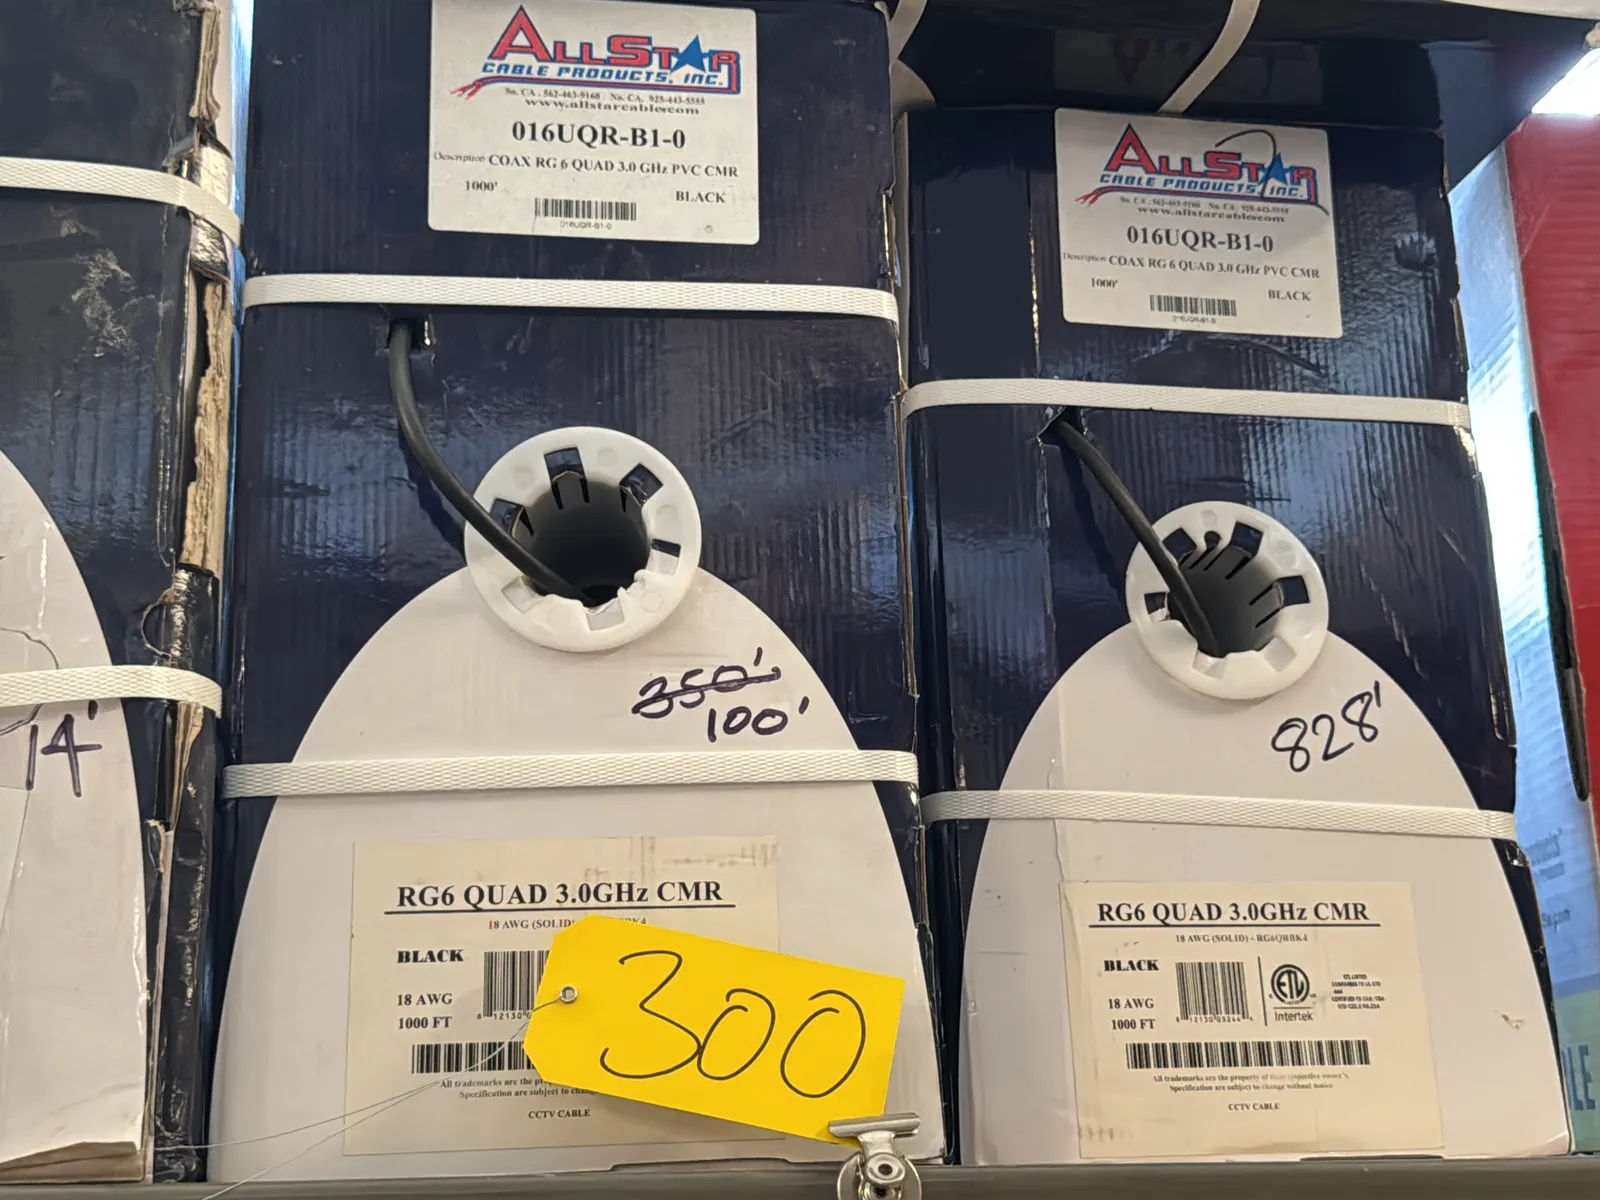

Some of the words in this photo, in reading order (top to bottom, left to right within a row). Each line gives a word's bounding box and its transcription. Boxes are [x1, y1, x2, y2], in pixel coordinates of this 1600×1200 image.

[481, 62, 549, 77] CABLE
[684, 73, 724, 86] INC.
[525, 98, 700, 115] www.allstarcable.com
[512, 121, 686, 149] 016UQR-B1-0
[488, 154, 531, 167] COAX
[536, 156, 557, 169] RG
[560, 158, 568, 169] 6
[572, 159, 614, 173] QUAD
[617, 161, 637, 172] 3.0
[639, 163, 668, 174] GHz
[672, 164, 701, 176] PVC
[704, 165, 738, 177] CMR
[465, 180, 498, 192] 1000'
[1100, 173, 1156, 187] CABLE
[1269, 186, 1304, 198] INC.
[676, 190, 726, 204] BLACK
[1127, 225, 1273, 253] 016UQR-B1-0
[1108, 255, 1144, 267] COAX
[1148, 258, 1166, 269] RG
[1169, 258, 1176, 269] 6
[1178, 260, 1215, 272] QUAD
[1217, 262, 1234, 273] 3.0
[1235, 263, 1261, 275] GHz
[1264, 265, 1288, 277] PVC
[1290, 267, 1320, 279] CMR
[1268, 289, 1312, 302] BLACK
[707, 696, 809, 743] 100'
[1271, 680, 1381, 773] 828'
[396, 885, 455, 907] RG6
[464, 884, 547, 911] QUAD
[555, 882, 649, 905] 3.0GHz
[657, 880, 723, 902] CMR
[1097, 902, 1146, 922] RG6
[1152, 902, 1222, 926] QUAD
[1229, 902, 1308, 922] 3.0GHz
[1313, 902, 1370, 921] CMR
[488, 920, 500, 930] 18
[502, 919, 529, 930] AWG
[1176, 934, 1186, 943] 18
[1187, 934, 1210, 943] AWG
[1211, 934, 1249, 943] (SOLID)
[397, 949, 464, 963] BLACK
[1103, 960, 1160, 972] BLACK
[397, 994, 412, 1006] 18
[416, 993, 453, 1005] AWG
[1108, 998, 1121, 1010] 18
[1123, 998, 1155, 1009] AWG
[398, 1016, 429, 1029] 1000
[432, 1016, 453, 1029] FT
[476, 1012, 482, 1020] 8
[1274, 1010, 1314, 1022] Intertek
[600, 950, 867, 1099] 300
[1111, 1018, 1137, 1030] 1000
[1140, 1018, 1156, 1030] FT
[440, 1079, 452, 1088] All
[454, 1078, 502, 1087] trademarks
[520, 1078, 533, 1086] the
[1164, 1074, 1204, 1082] trademarks
[459, 1089, 512, 1099] Specification
[530, 1088, 559, 1098] subject
[1169, 1084, 1213, 1093] Specification
[1227, 1083, 1251, 1092] subject
[1228, 1103, 1250, 1111] CCTV
[1252, 1102, 1280, 1110] CABLE
[528, 1110, 555, 1119] CCTV
[557, 1108, 591, 1118] CABLE
